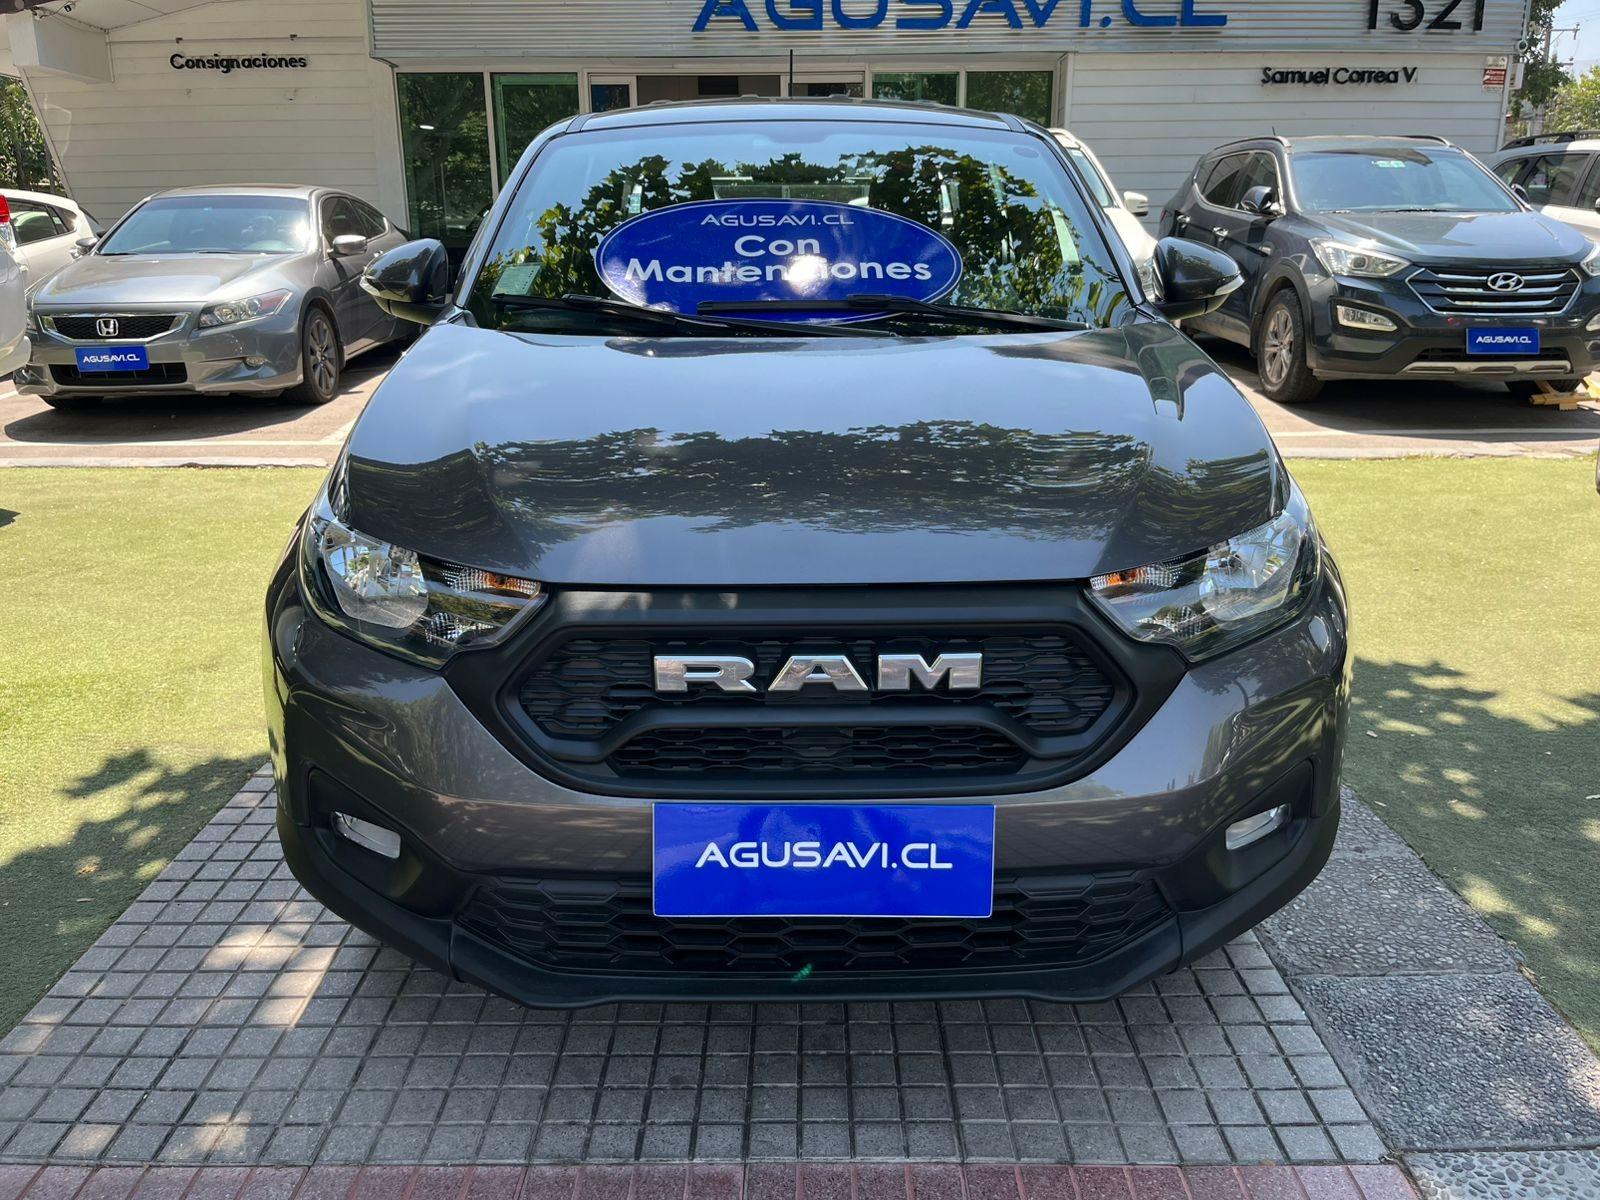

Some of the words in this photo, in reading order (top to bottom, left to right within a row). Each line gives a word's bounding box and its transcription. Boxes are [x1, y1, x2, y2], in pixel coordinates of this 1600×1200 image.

[169, 53, 307, 74] Consignaciones
[1261, 67, 1330, 84] Samuel
[1333, 67, 1399, 84] Correa
[700, 213, 855, 227] AGUSAVI.CL
[734, 234, 820, 257] Con
[623, 256, 932, 284] Manteniones
[1475, 335, 1532, 344] AGUSAVI.CL
[82, 353, 140, 363] AGUSAVI.CL
[653, 652, 983, 692] RAM
[695, 841, 953, 869] AGUSAVI.CL
